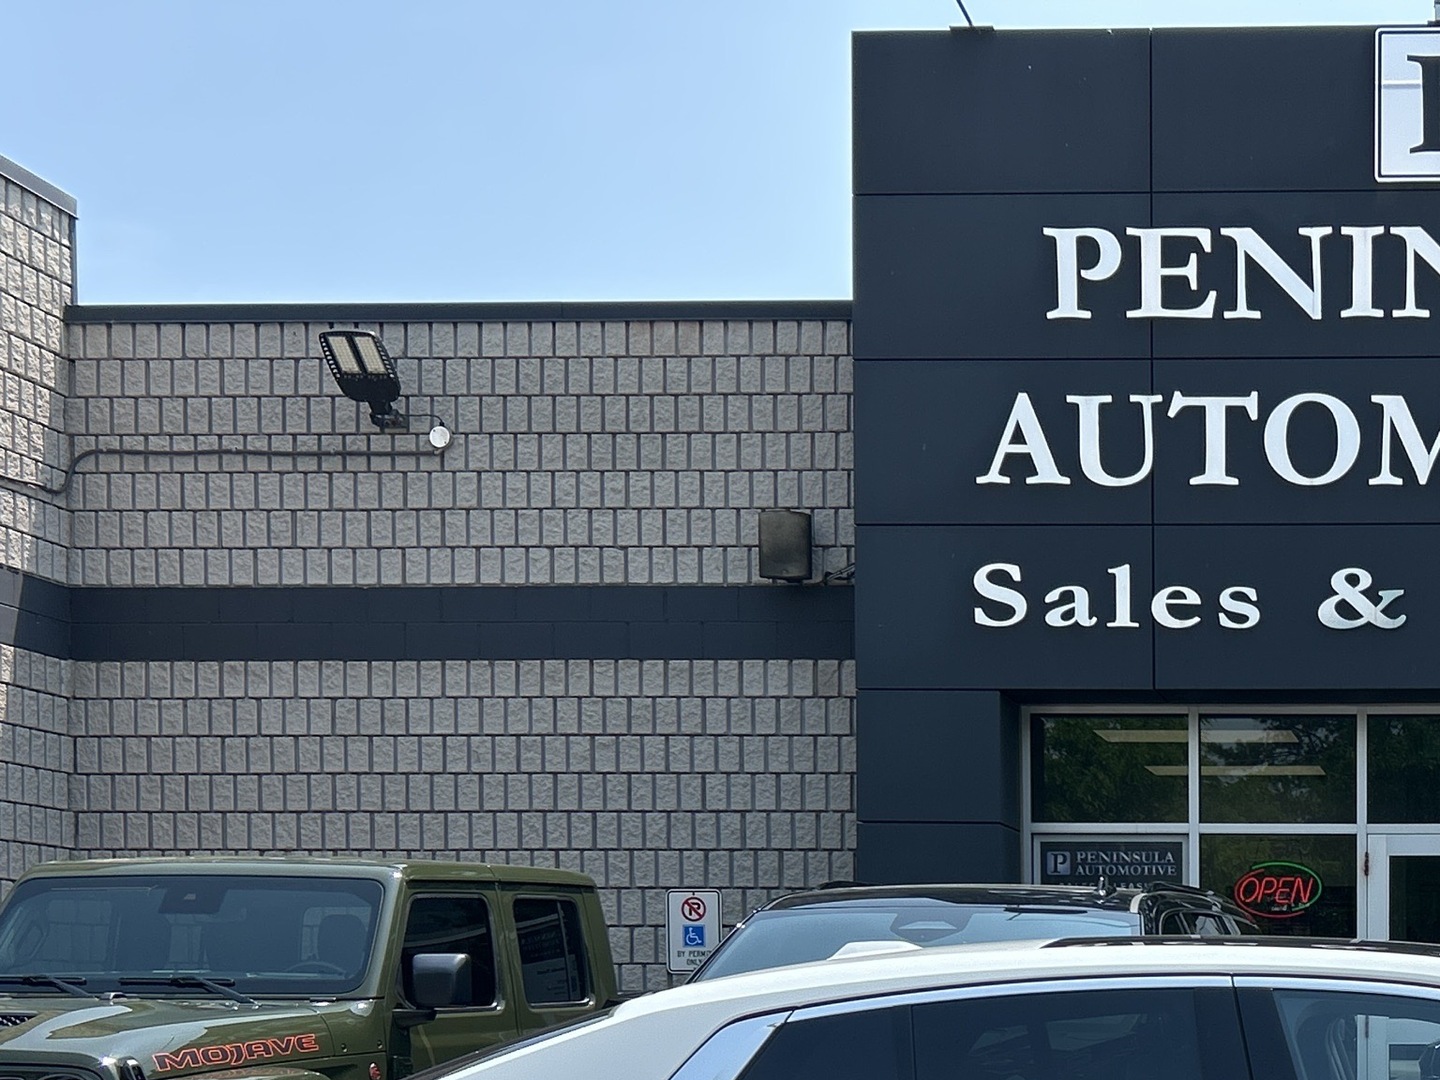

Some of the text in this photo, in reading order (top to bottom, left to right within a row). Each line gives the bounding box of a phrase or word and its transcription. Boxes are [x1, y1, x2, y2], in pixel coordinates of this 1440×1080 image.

[972, 562, 1262, 630] Sales
[1317, 566, 1407, 631] &
[1075, 851, 1175, 863] PENINSULA
[1075, 864, 1177, 876] AUTOMOTIVE
[1240, 876, 1314, 903] OPEN
[677, 950, 686, 958] BY
[152, 1033, 320, 1072] MOJAVE
